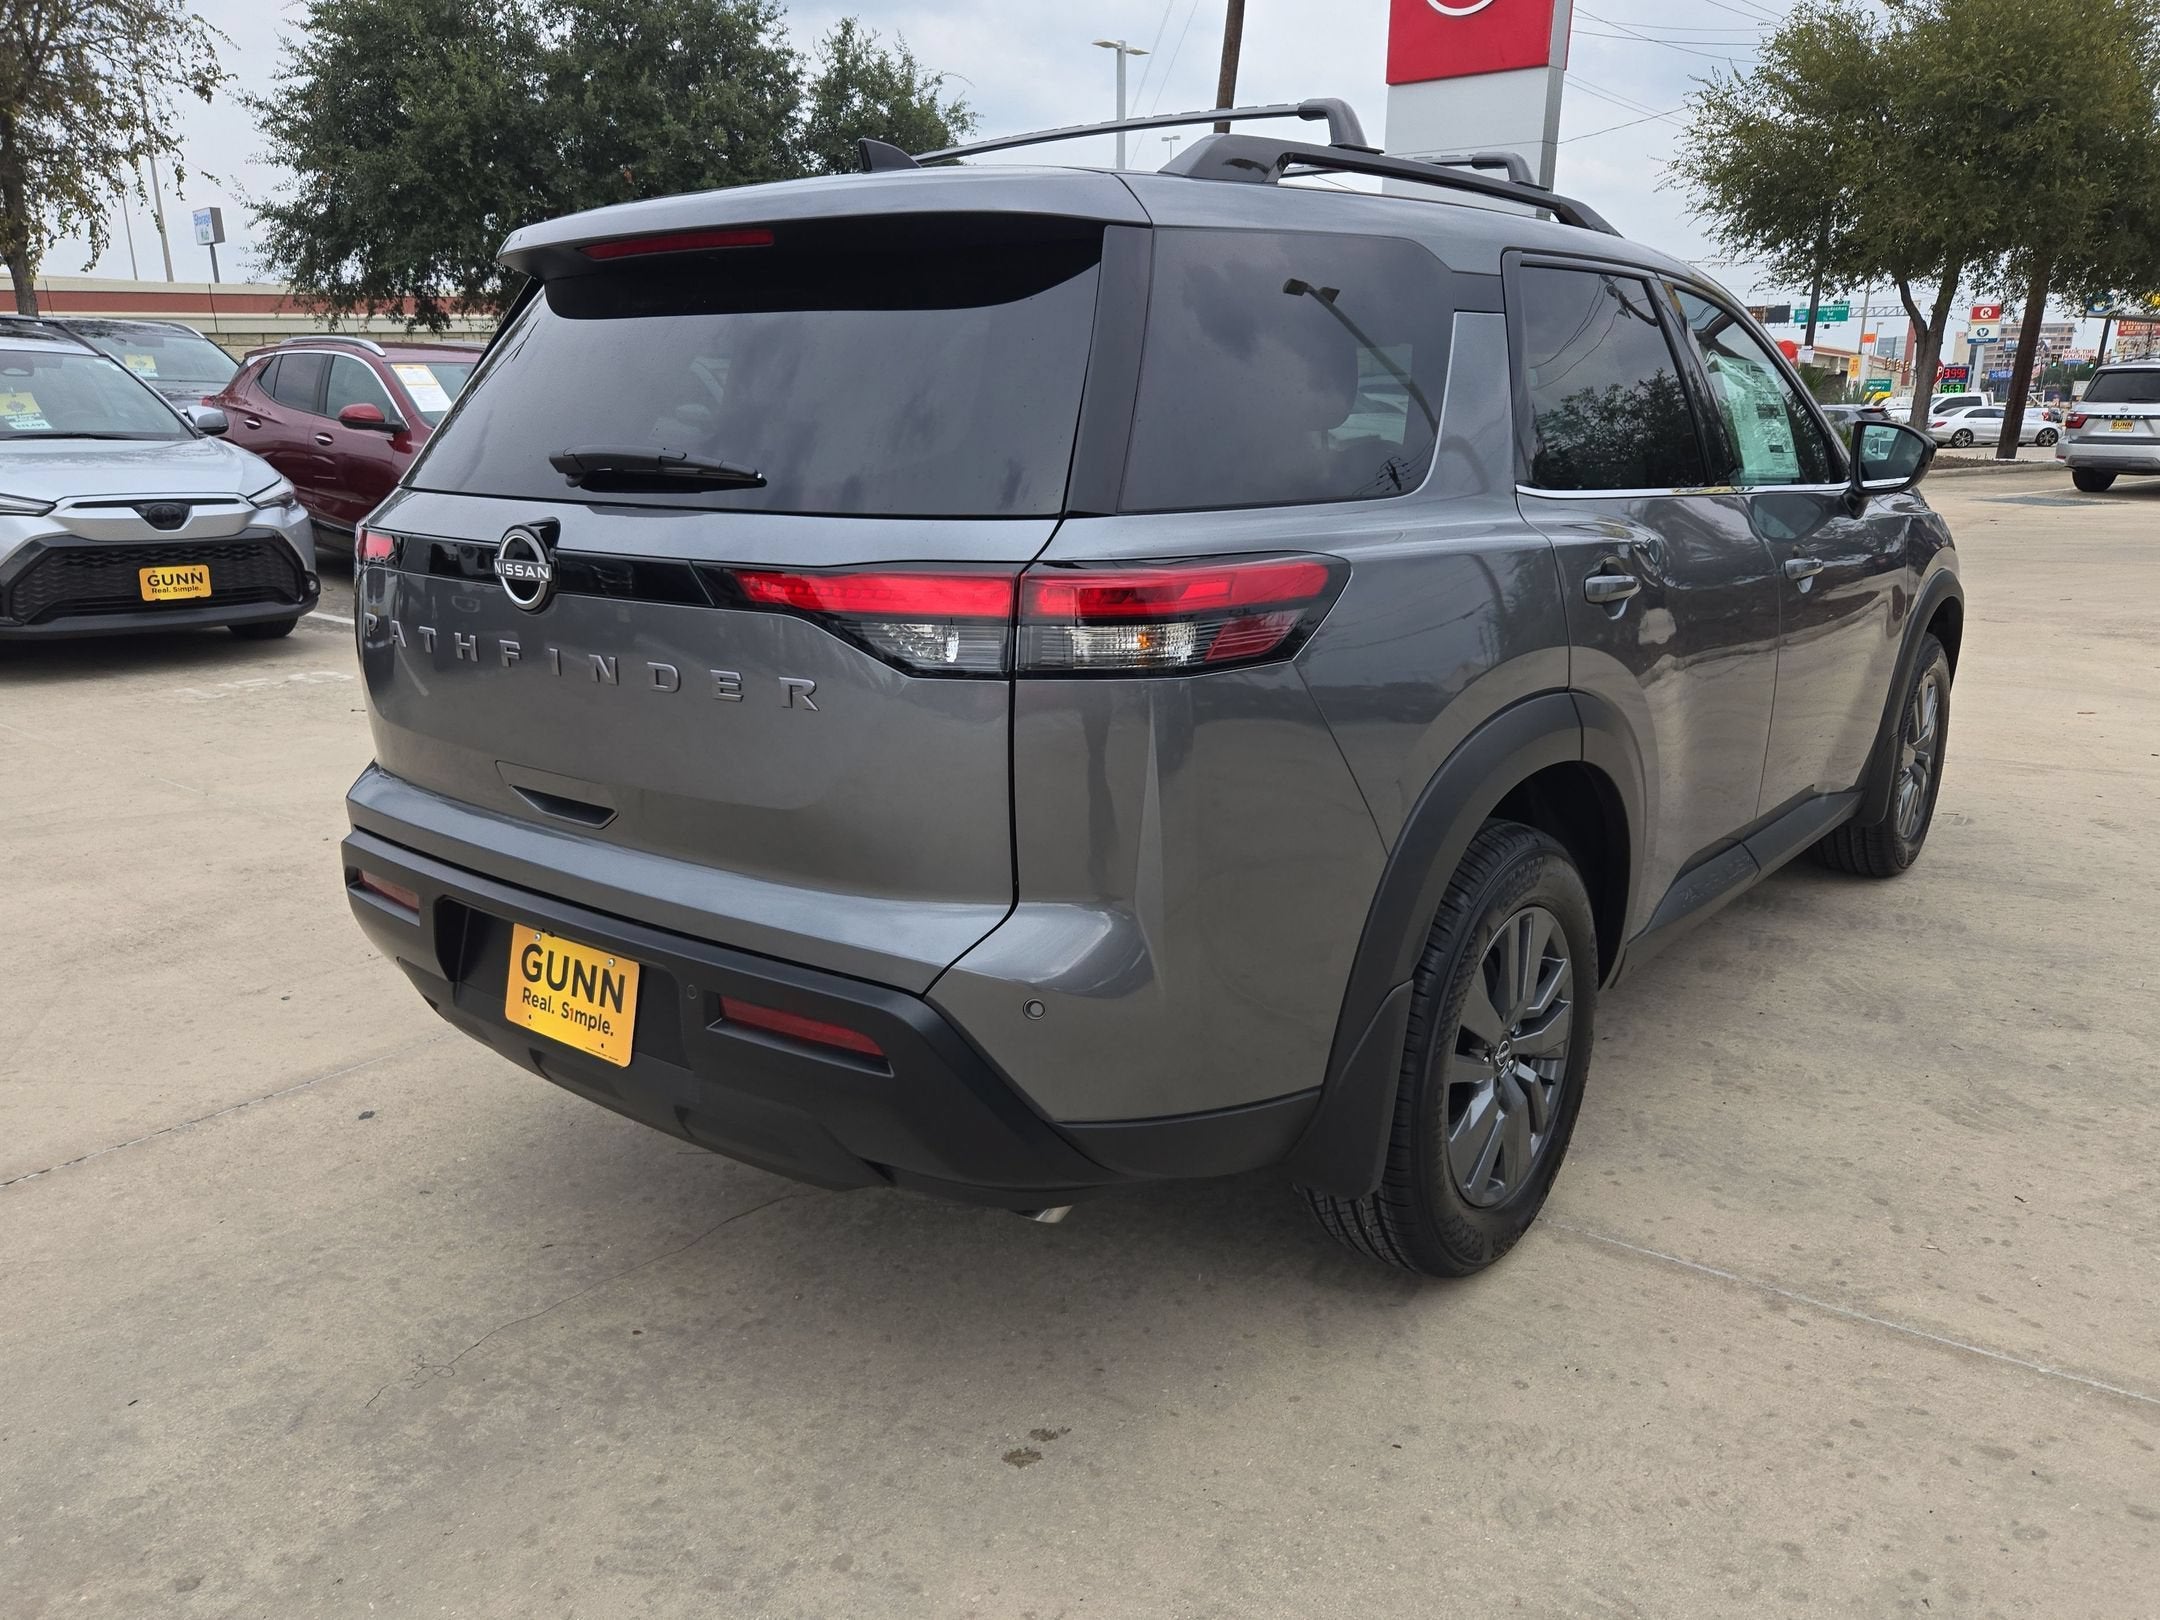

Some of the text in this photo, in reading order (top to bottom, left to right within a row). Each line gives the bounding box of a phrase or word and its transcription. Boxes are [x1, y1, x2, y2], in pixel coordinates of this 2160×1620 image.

[147, 571, 204, 587] GUNN
[495, 561, 550, 581] NISSAN
[151, 586, 171, 594] Real.
[365, 611, 820, 712] PATHFINDER
[521, 943, 626, 1014] GUNN
[522, 987, 555, 1014] Real.
